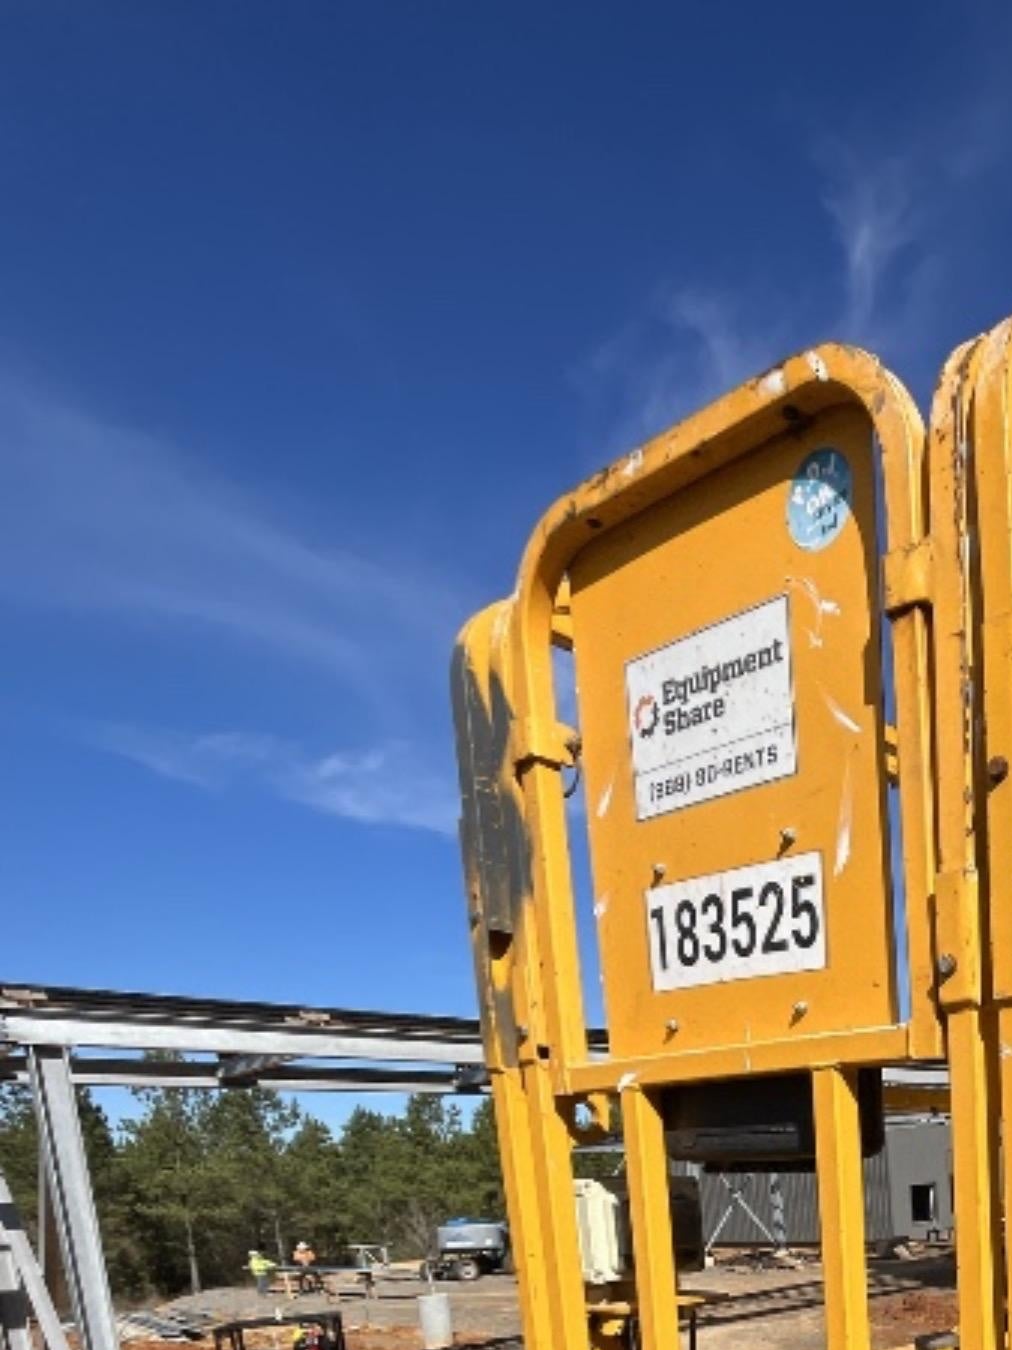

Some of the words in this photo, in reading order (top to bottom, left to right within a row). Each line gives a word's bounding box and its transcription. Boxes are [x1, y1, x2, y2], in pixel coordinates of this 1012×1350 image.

[661, 638, 784, 707] Equipment
[663, 697, 726, 736] Share
[650, 874, 821, 972] 183525
